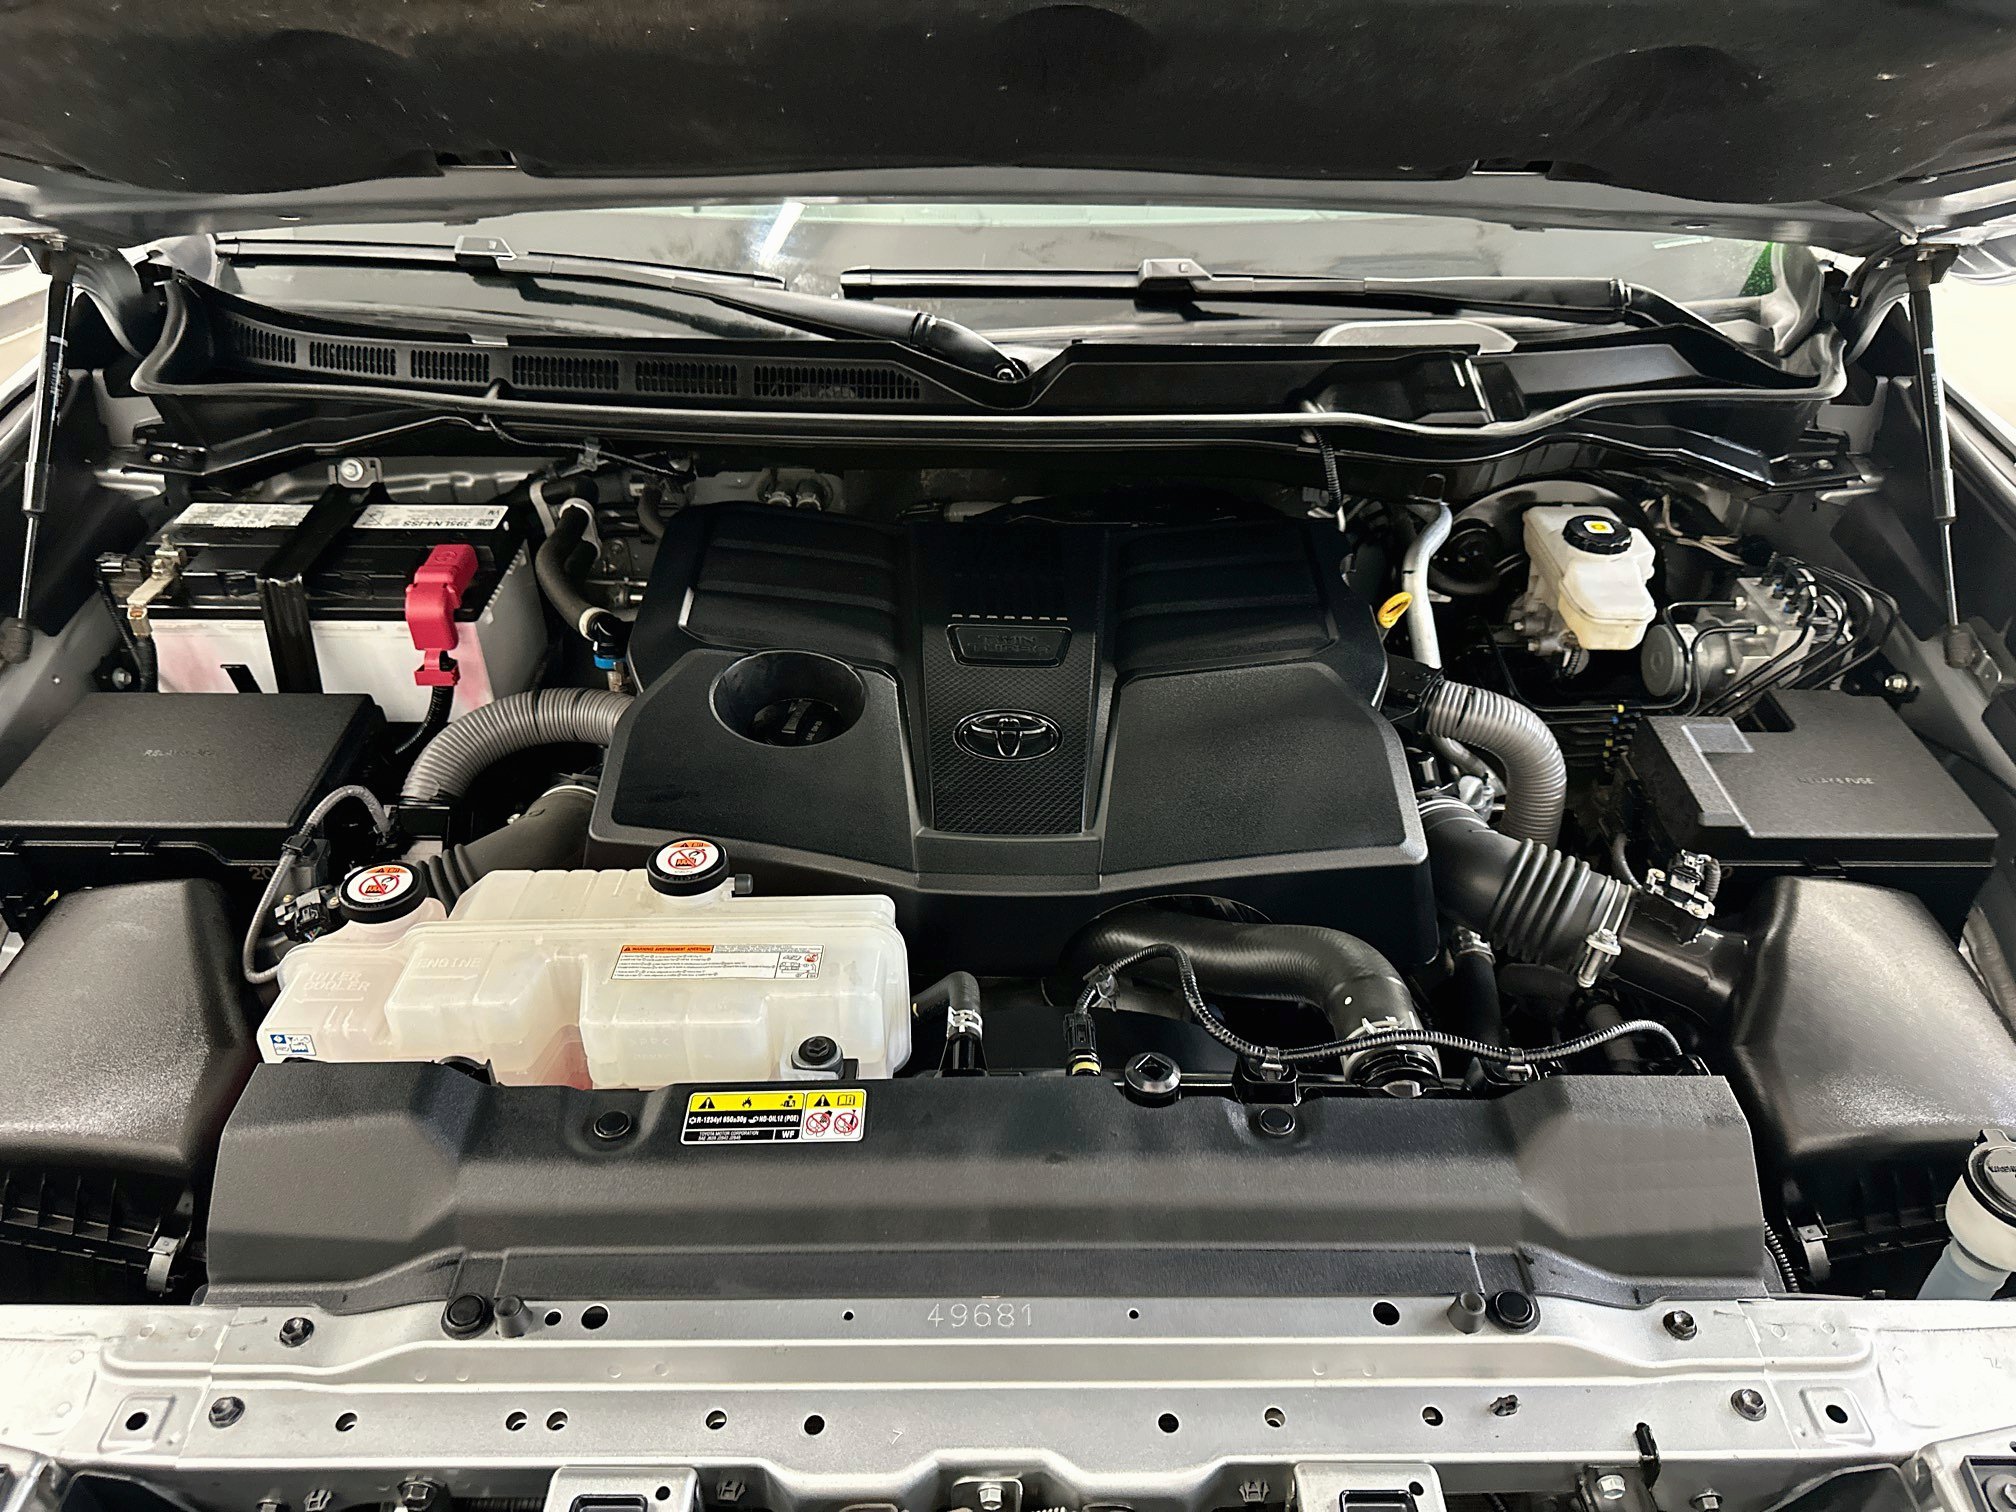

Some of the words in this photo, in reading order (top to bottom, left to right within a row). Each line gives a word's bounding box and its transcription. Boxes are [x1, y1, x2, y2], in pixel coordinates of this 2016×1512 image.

[416, 957, 482, 969] ENGINE
[307, 971, 363, 982] INTER
[303, 981, 371, 992] COOLER
[697, 1116, 722, 1124] R-1234yf
[782, 1130, 795, 1139] WF
[927, 1303, 1033, 1328] 49681
